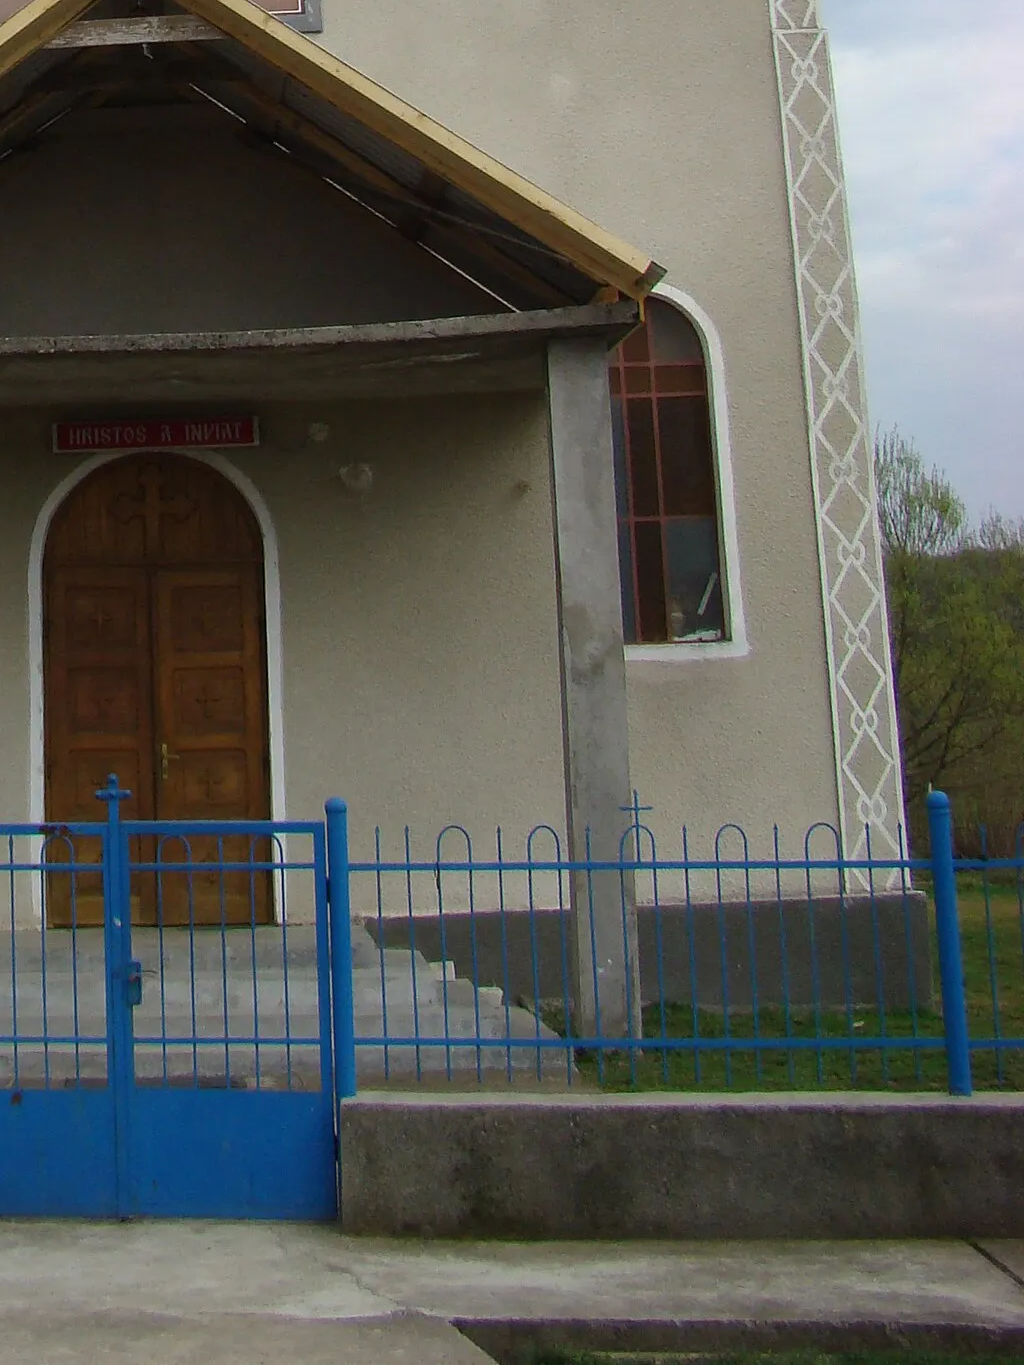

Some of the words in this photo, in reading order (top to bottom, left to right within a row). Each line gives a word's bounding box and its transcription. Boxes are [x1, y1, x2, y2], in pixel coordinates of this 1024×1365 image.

[69, 425, 147, 446] HRISTOS
[161, 424, 171, 442] A
[184, 421, 242, 442] INVIAT
